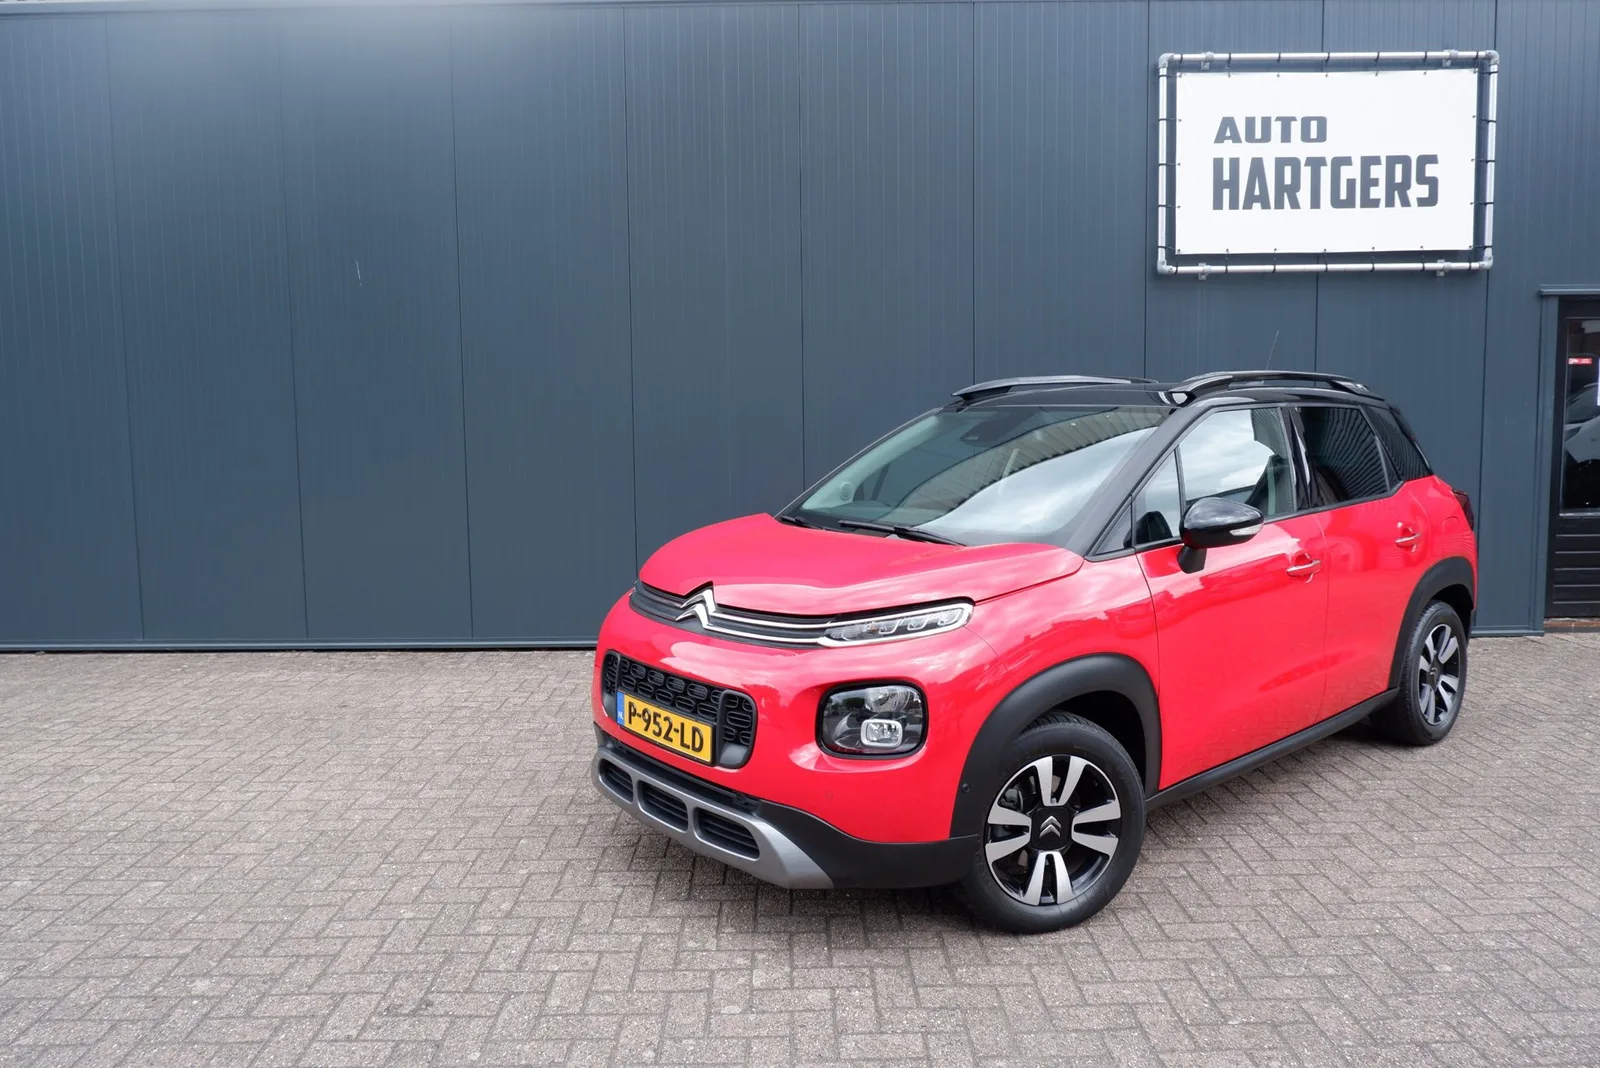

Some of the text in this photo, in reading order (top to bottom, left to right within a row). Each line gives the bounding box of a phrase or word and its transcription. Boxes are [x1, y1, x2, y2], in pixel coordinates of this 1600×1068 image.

[1213, 116, 1328, 144] AUTO
[1212, 154, 1439, 211] HARTGERS
[628, 701, 704, 753] P-952-LD
